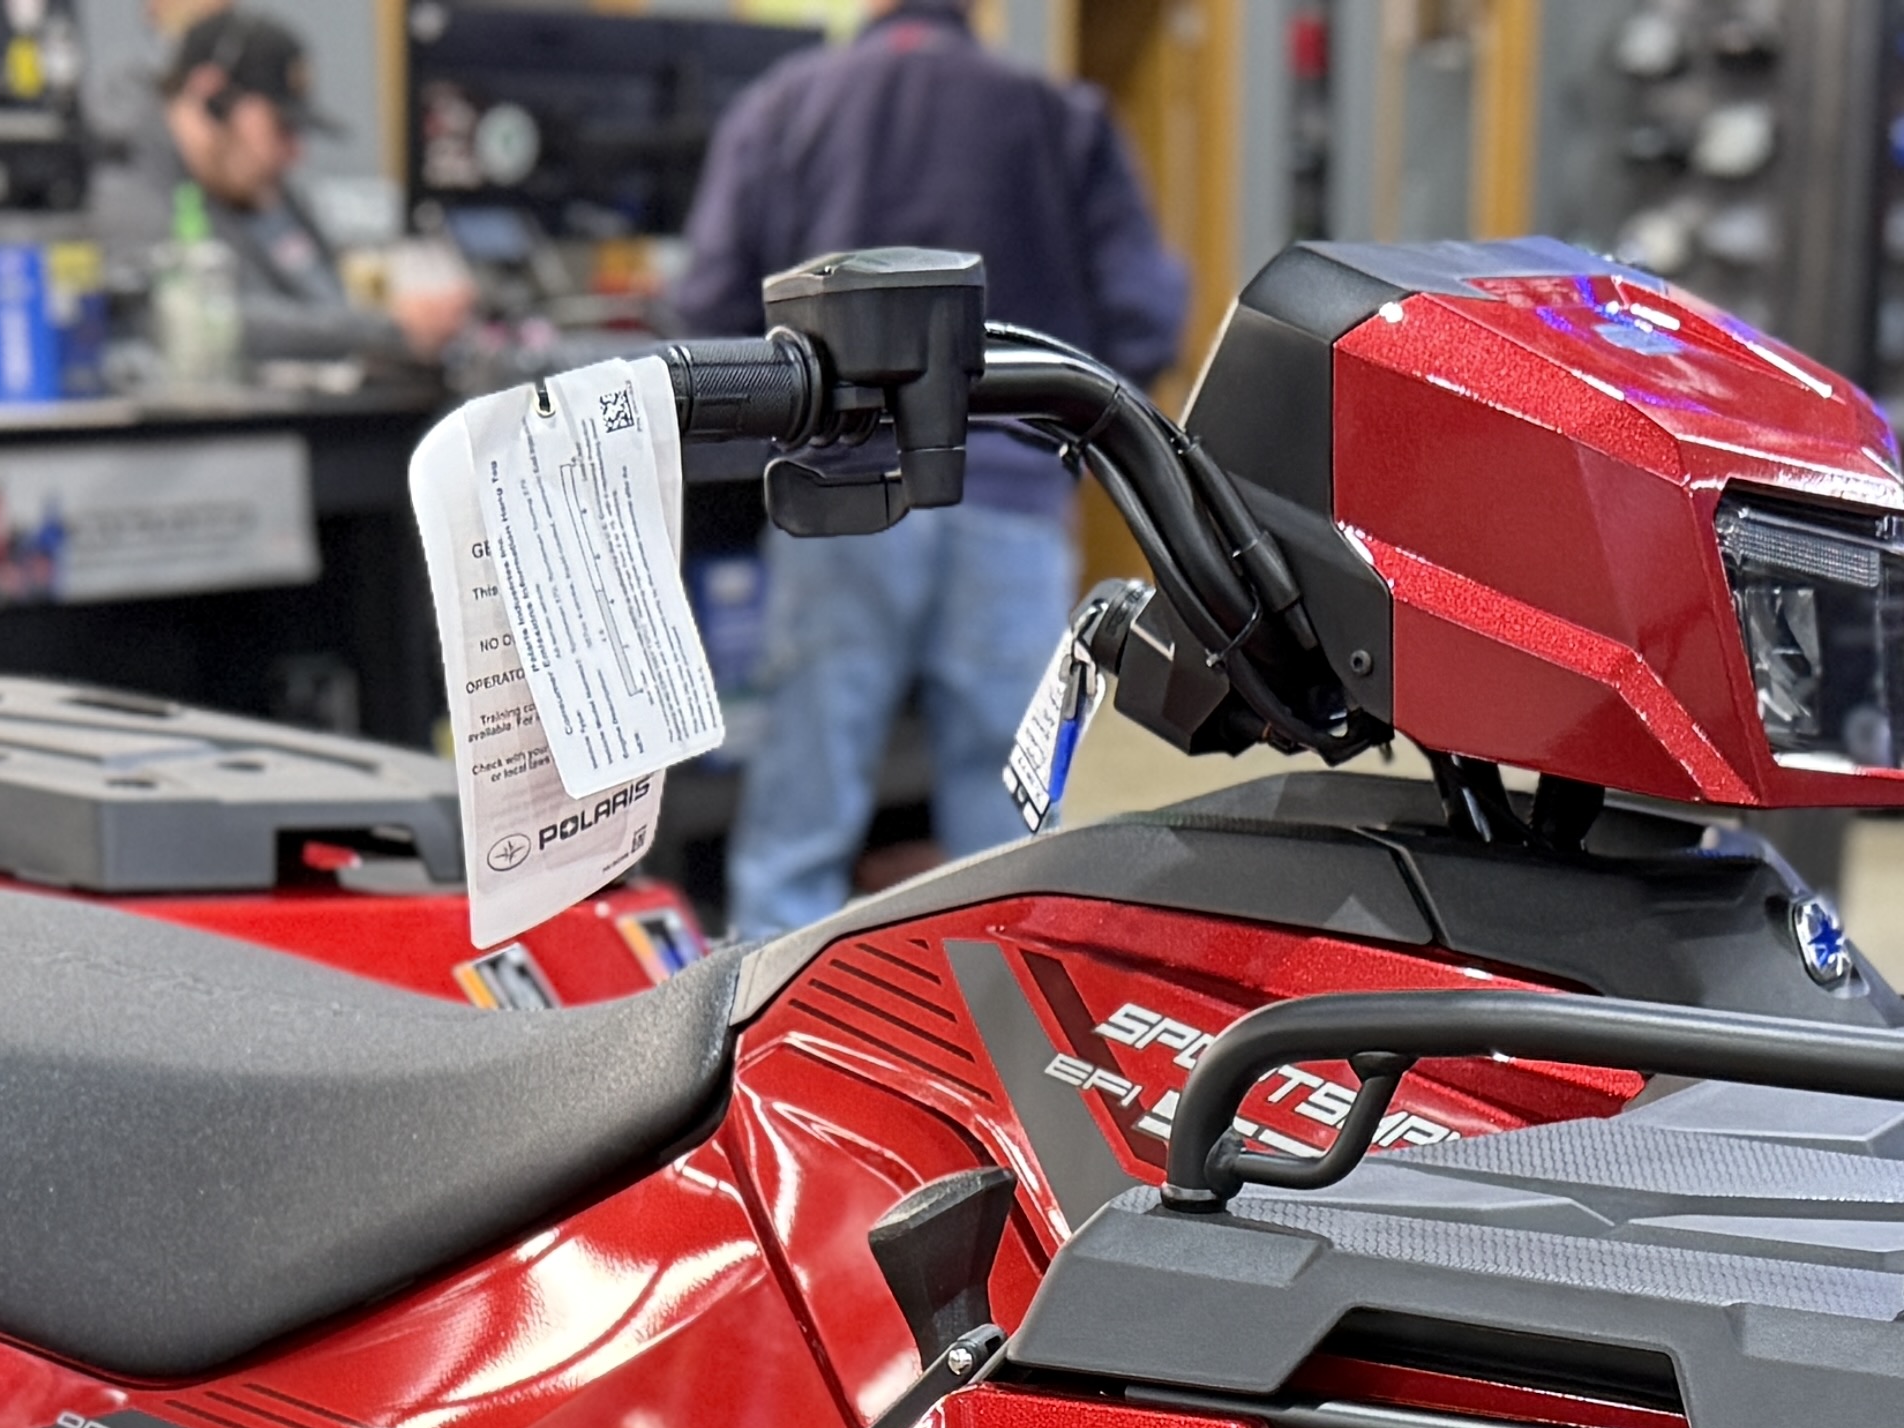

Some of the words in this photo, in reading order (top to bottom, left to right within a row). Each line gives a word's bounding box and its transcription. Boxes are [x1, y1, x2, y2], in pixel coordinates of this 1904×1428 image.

[472, 585, 499, 602] This
[480, 638, 500, 653] NO
[465, 668, 526, 695] OPERATO
[480, 707, 522, 727] Training
[471, 757, 504, 777] Check
[538, 773, 651, 851] POLARIS
[1044, 1053, 1144, 1109] EFI
